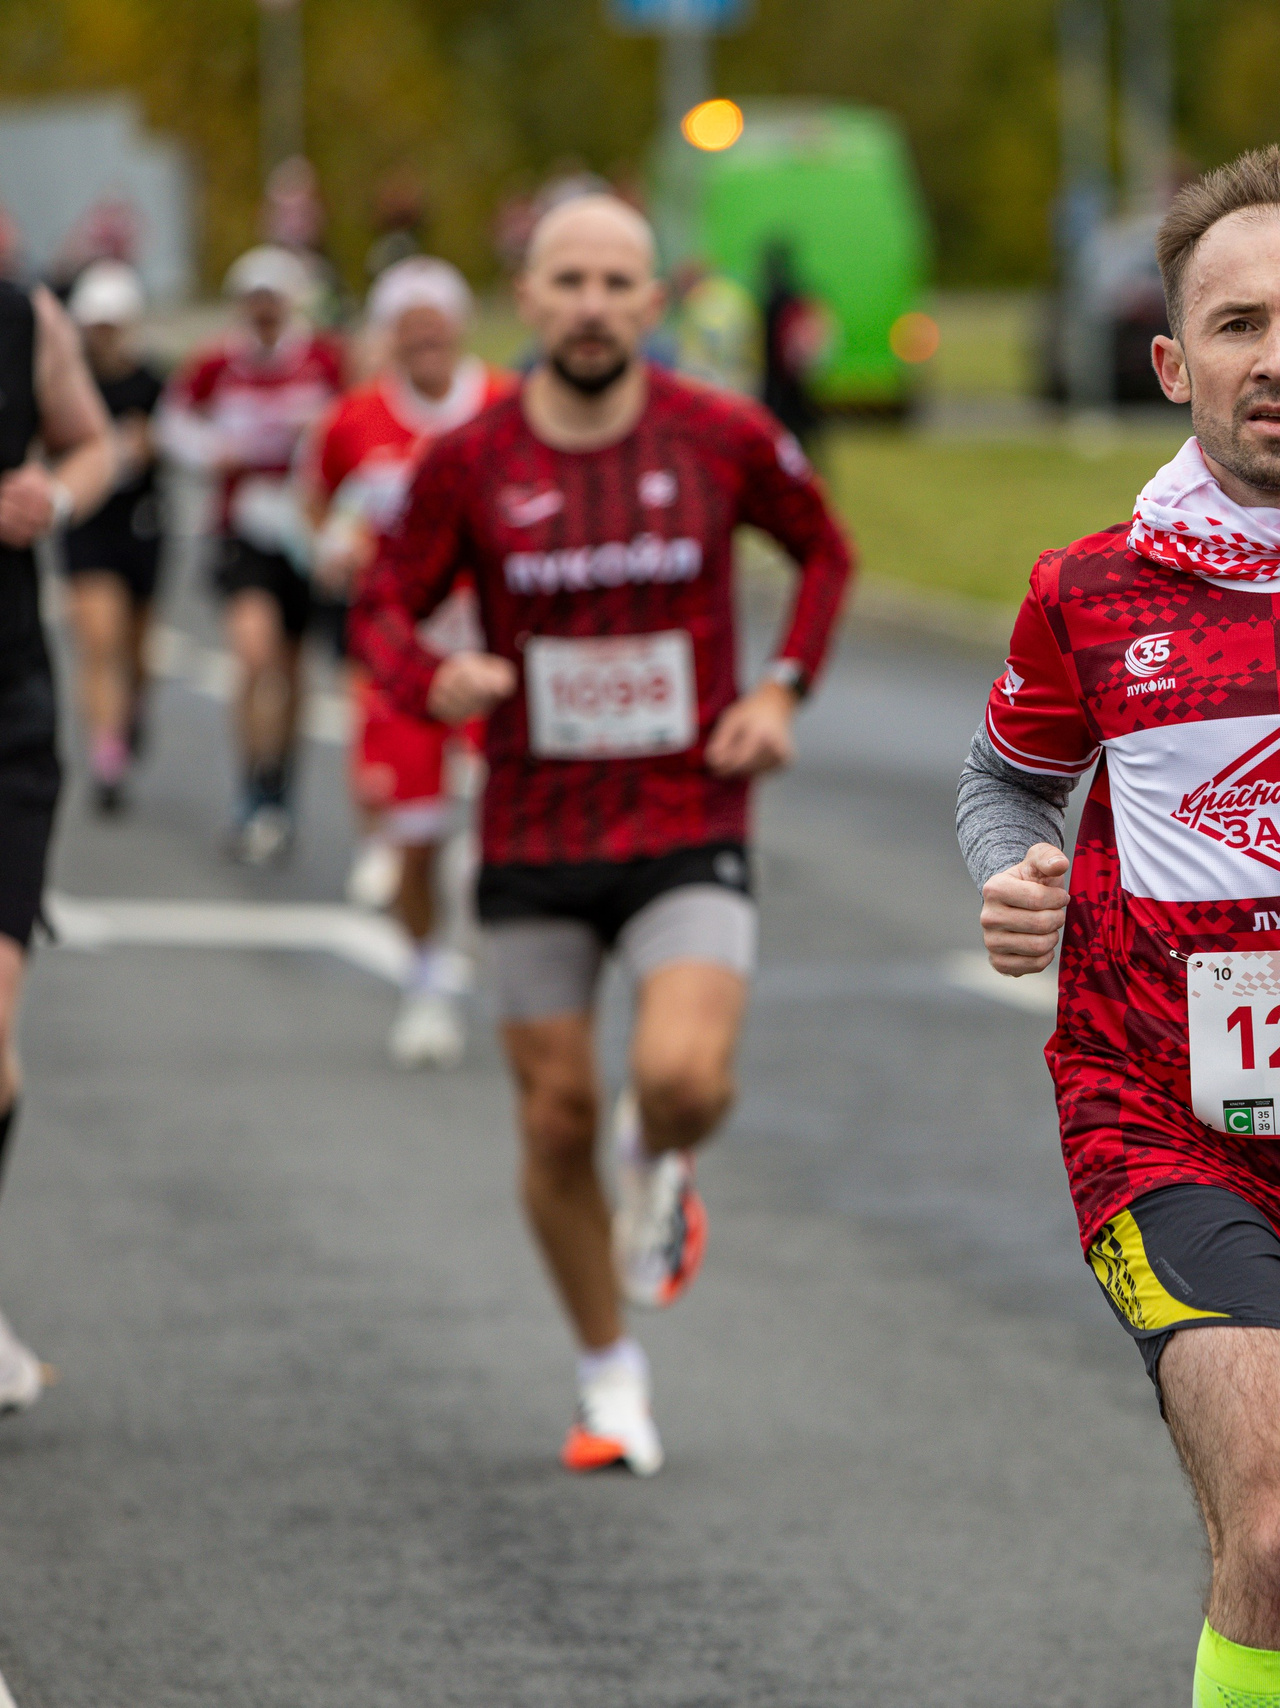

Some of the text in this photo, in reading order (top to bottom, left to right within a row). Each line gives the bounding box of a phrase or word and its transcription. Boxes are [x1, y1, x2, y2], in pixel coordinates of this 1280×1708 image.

[1139, 638, 1170, 664] 35
[1126, 677, 1176, 697] ЛУКОЙЛ
[1213, 967, 1232, 981] 10
